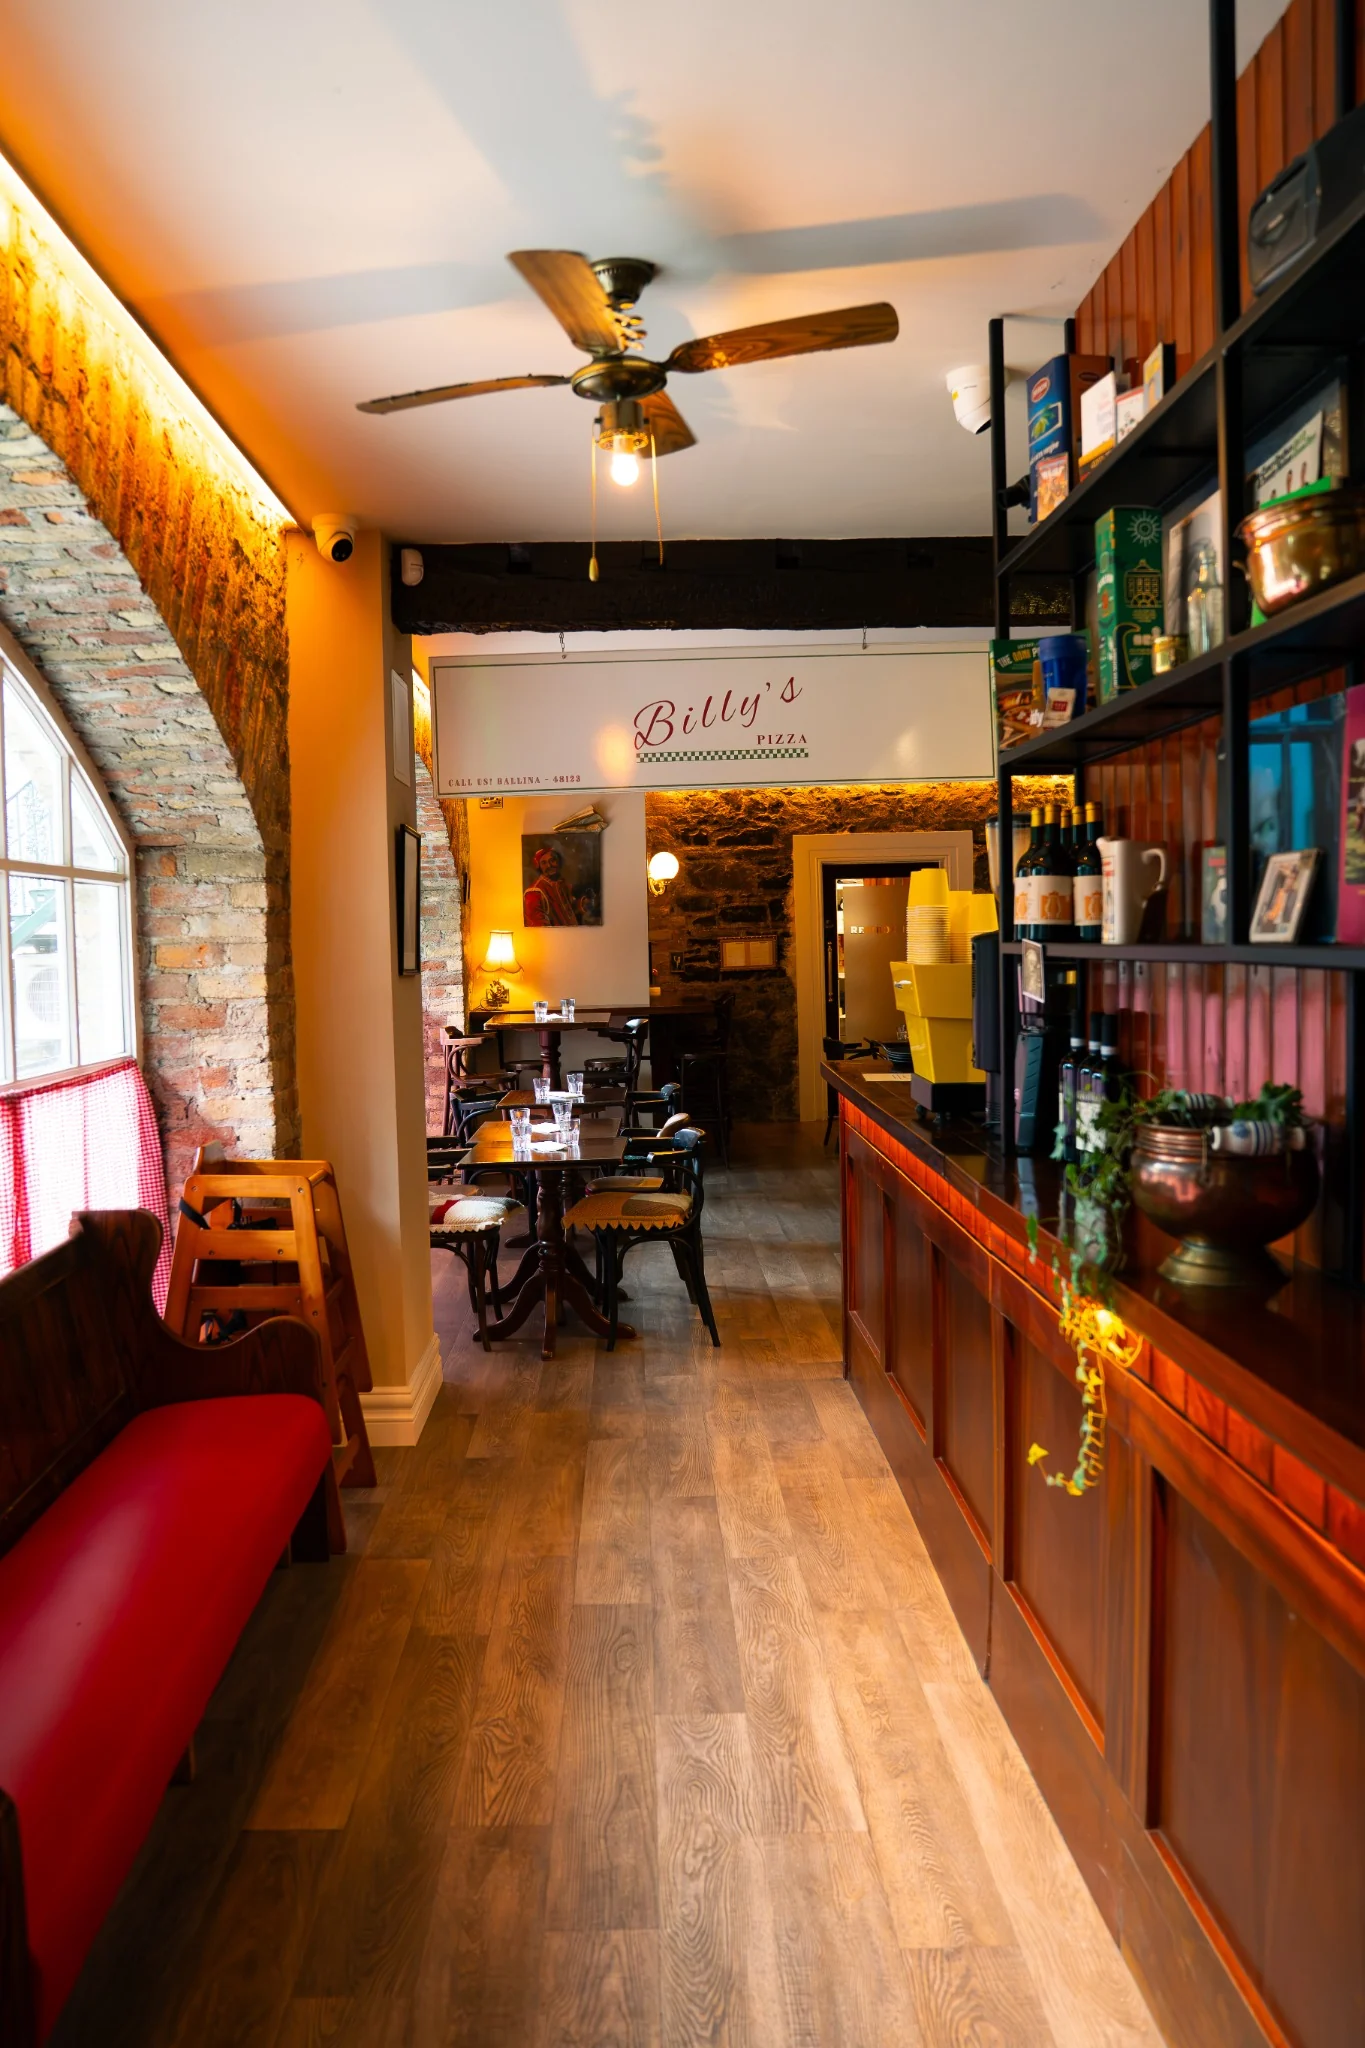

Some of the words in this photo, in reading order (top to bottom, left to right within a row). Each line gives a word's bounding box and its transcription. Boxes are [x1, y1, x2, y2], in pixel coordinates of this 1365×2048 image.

[634, 676, 803, 750] Billy's
[757, 733, 807, 745] PIZZA
[448, 778, 473, 787] CALL
[477, 777, 493, 786] US!
[497, 776, 541, 786] BALLINA
[552, 774, 581, 784] 48123
